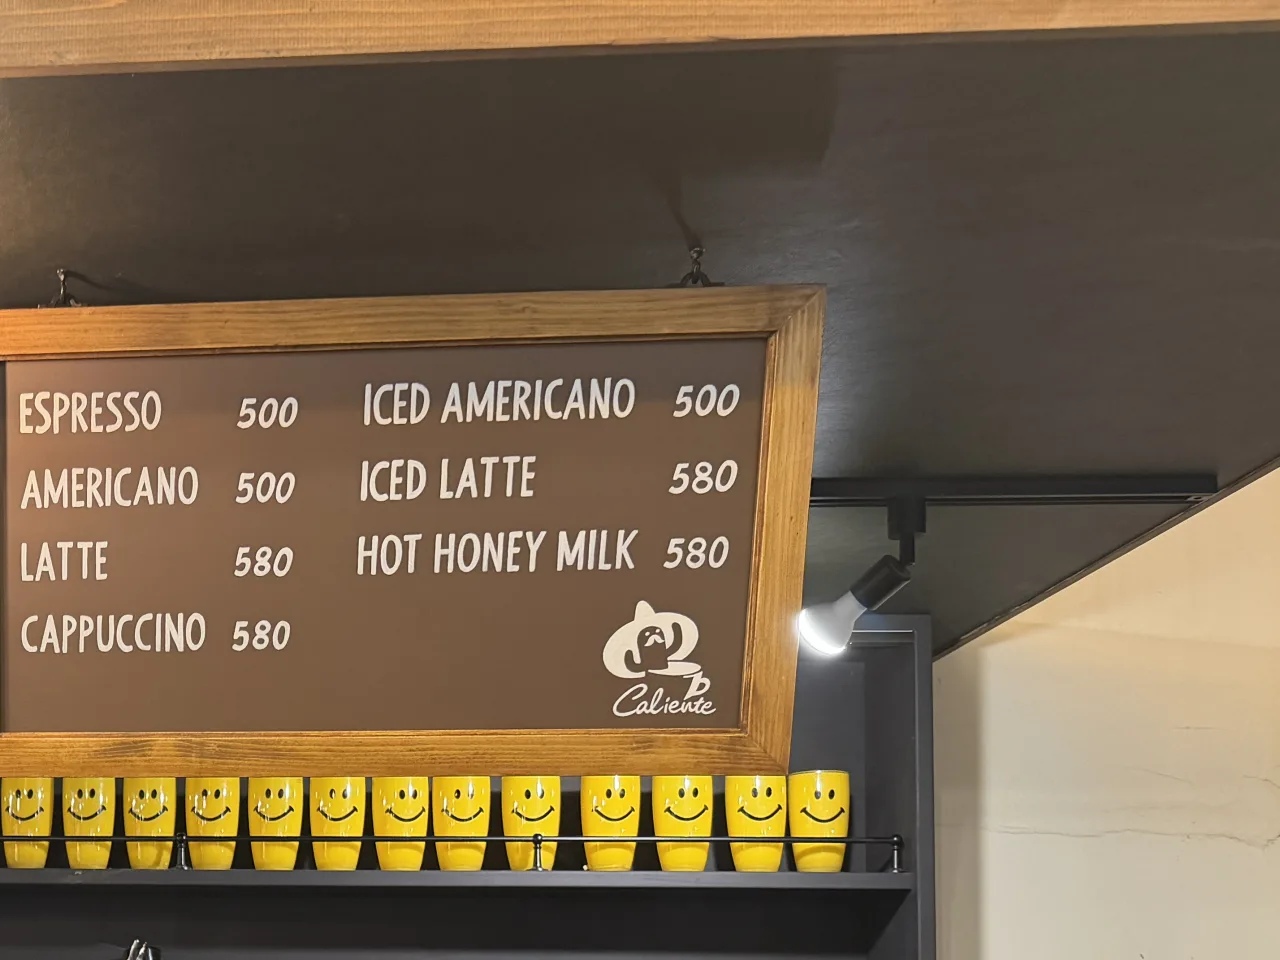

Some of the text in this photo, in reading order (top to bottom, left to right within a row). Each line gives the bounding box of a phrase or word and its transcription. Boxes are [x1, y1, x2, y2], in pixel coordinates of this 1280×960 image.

[20, 391, 299, 434] ESPRESSO 500
[363, 378, 740, 425] ICED AMERICANO 500
[21, 466, 296, 510] AMERICANO 500
[360, 456, 738, 502] ICED LATTE 580
[21, 540, 294, 582] LATTE 580
[358, 530, 729, 575] HOT HONEY MILK 580
[21, 613, 291, 654] CAPPUCCINO 580
[612, 683, 717, 717] Caliente
